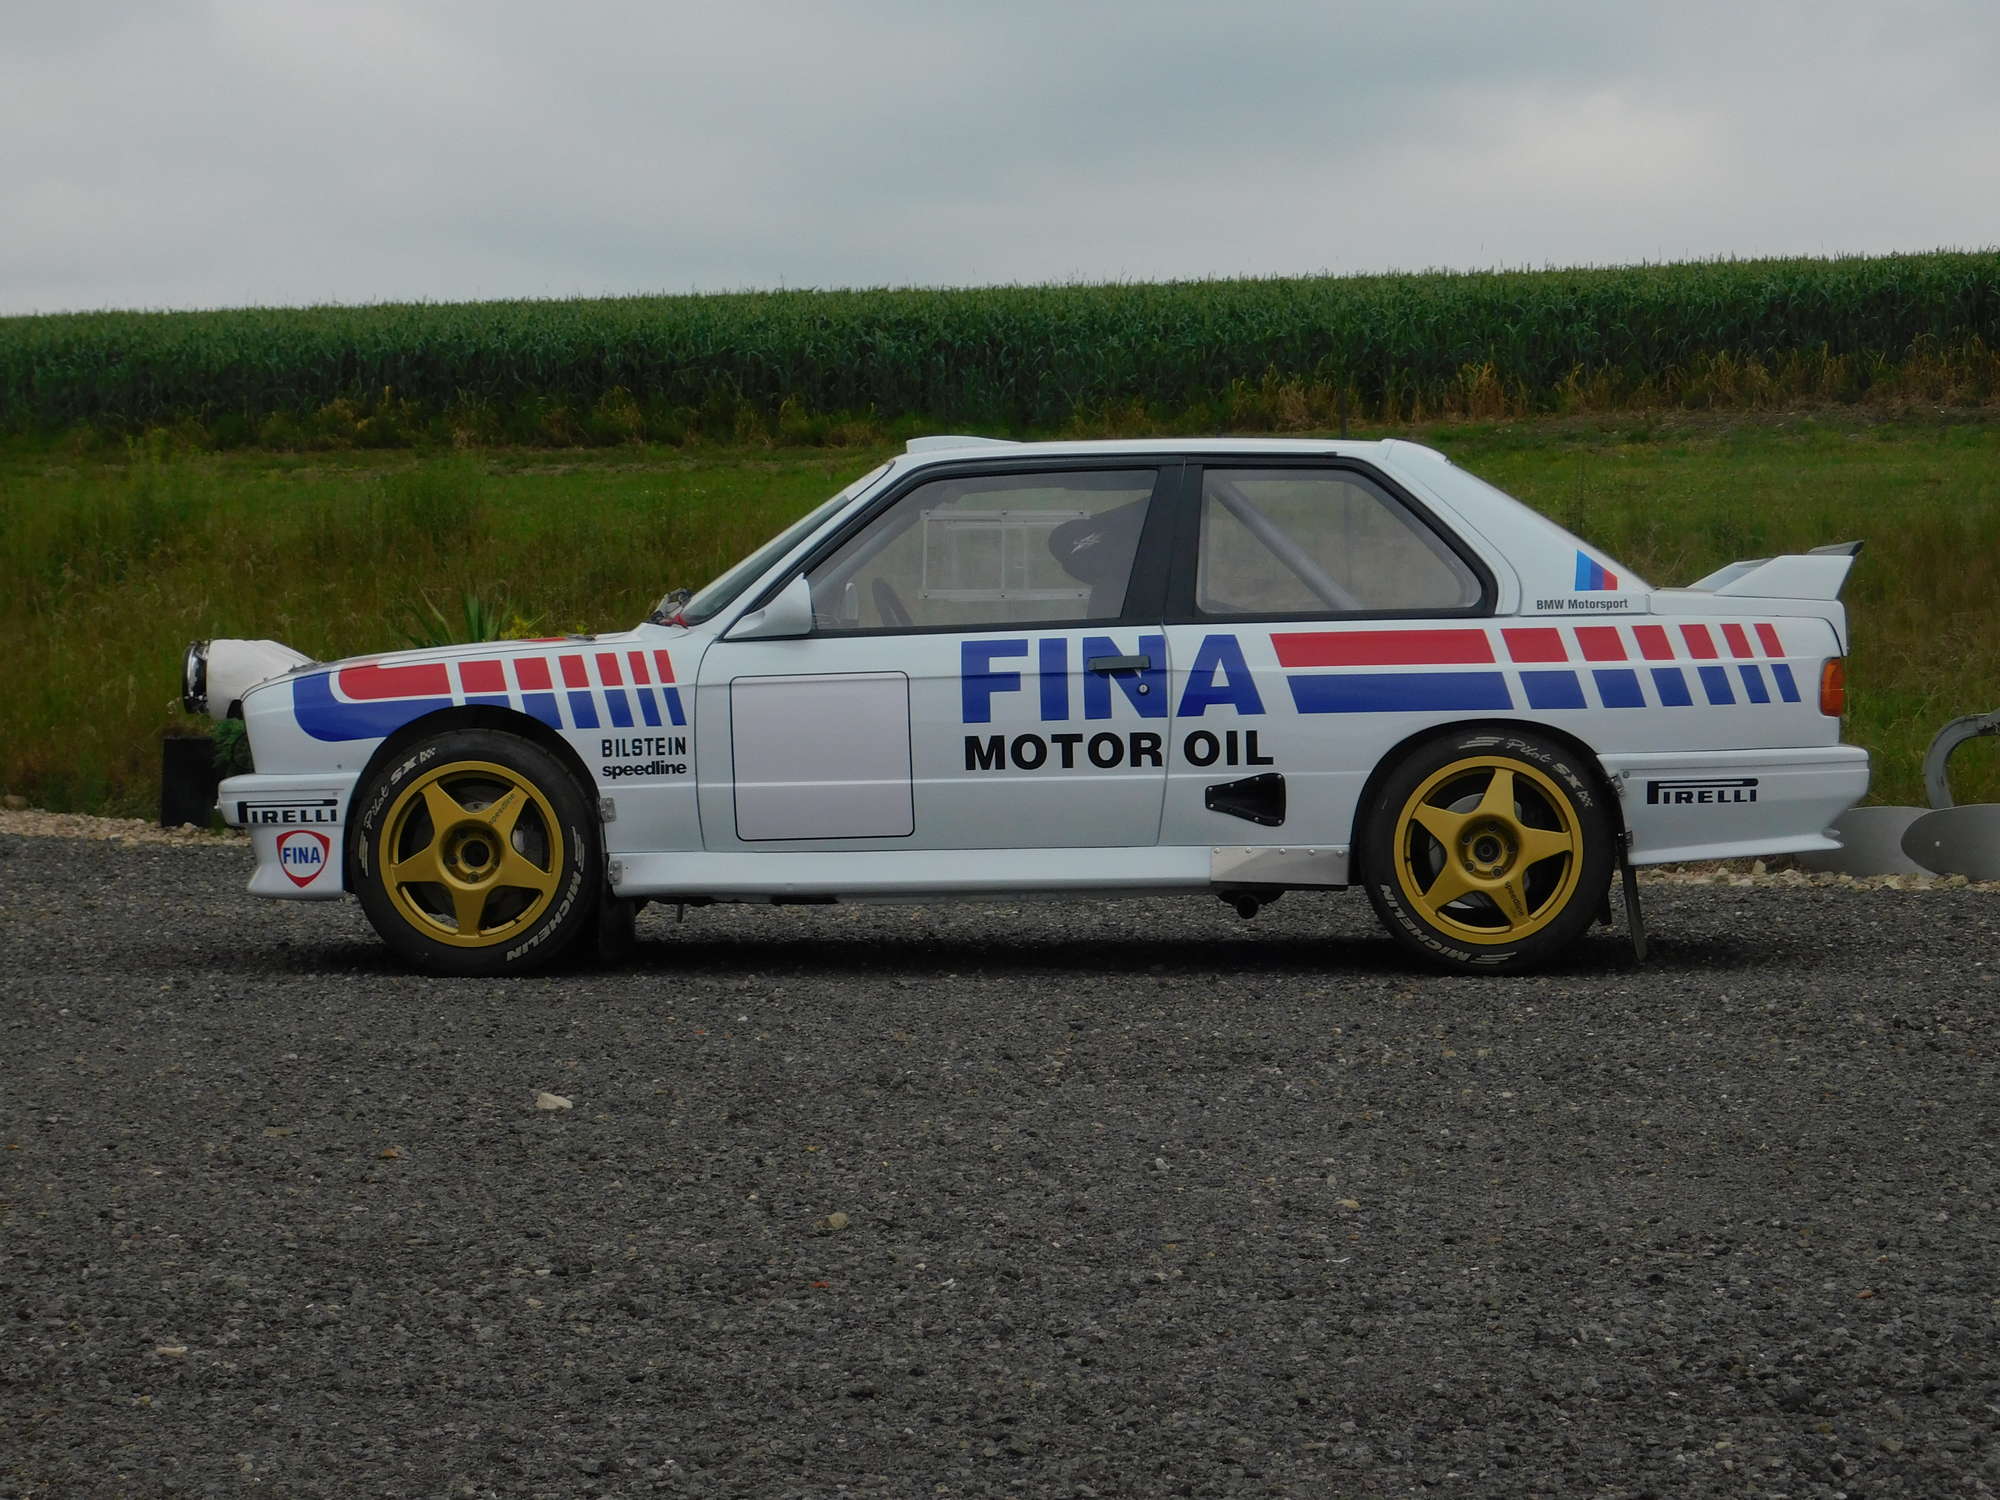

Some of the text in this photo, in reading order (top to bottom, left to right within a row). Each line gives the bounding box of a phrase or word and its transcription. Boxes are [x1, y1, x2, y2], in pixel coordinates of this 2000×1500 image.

[1536, 598, 1628, 611] BMW Motorsport
[961, 634, 1267, 723] FINA
[601, 736, 686, 757] BILSTEIN
[964, 730, 1274, 770] MOTOR OIL
[602, 760, 687, 780] speedline
[1506, 738, 1583, 789] Pilot SX
[1647, 778, 1759, 805] PIRELLI
[237, 799, 338, 823] PIRELLI
[283, 847, 321, 864] FINA
[507, 870, 582, 962] MICHELIN
[1379, 884, 1472, 962] MICHELIN
